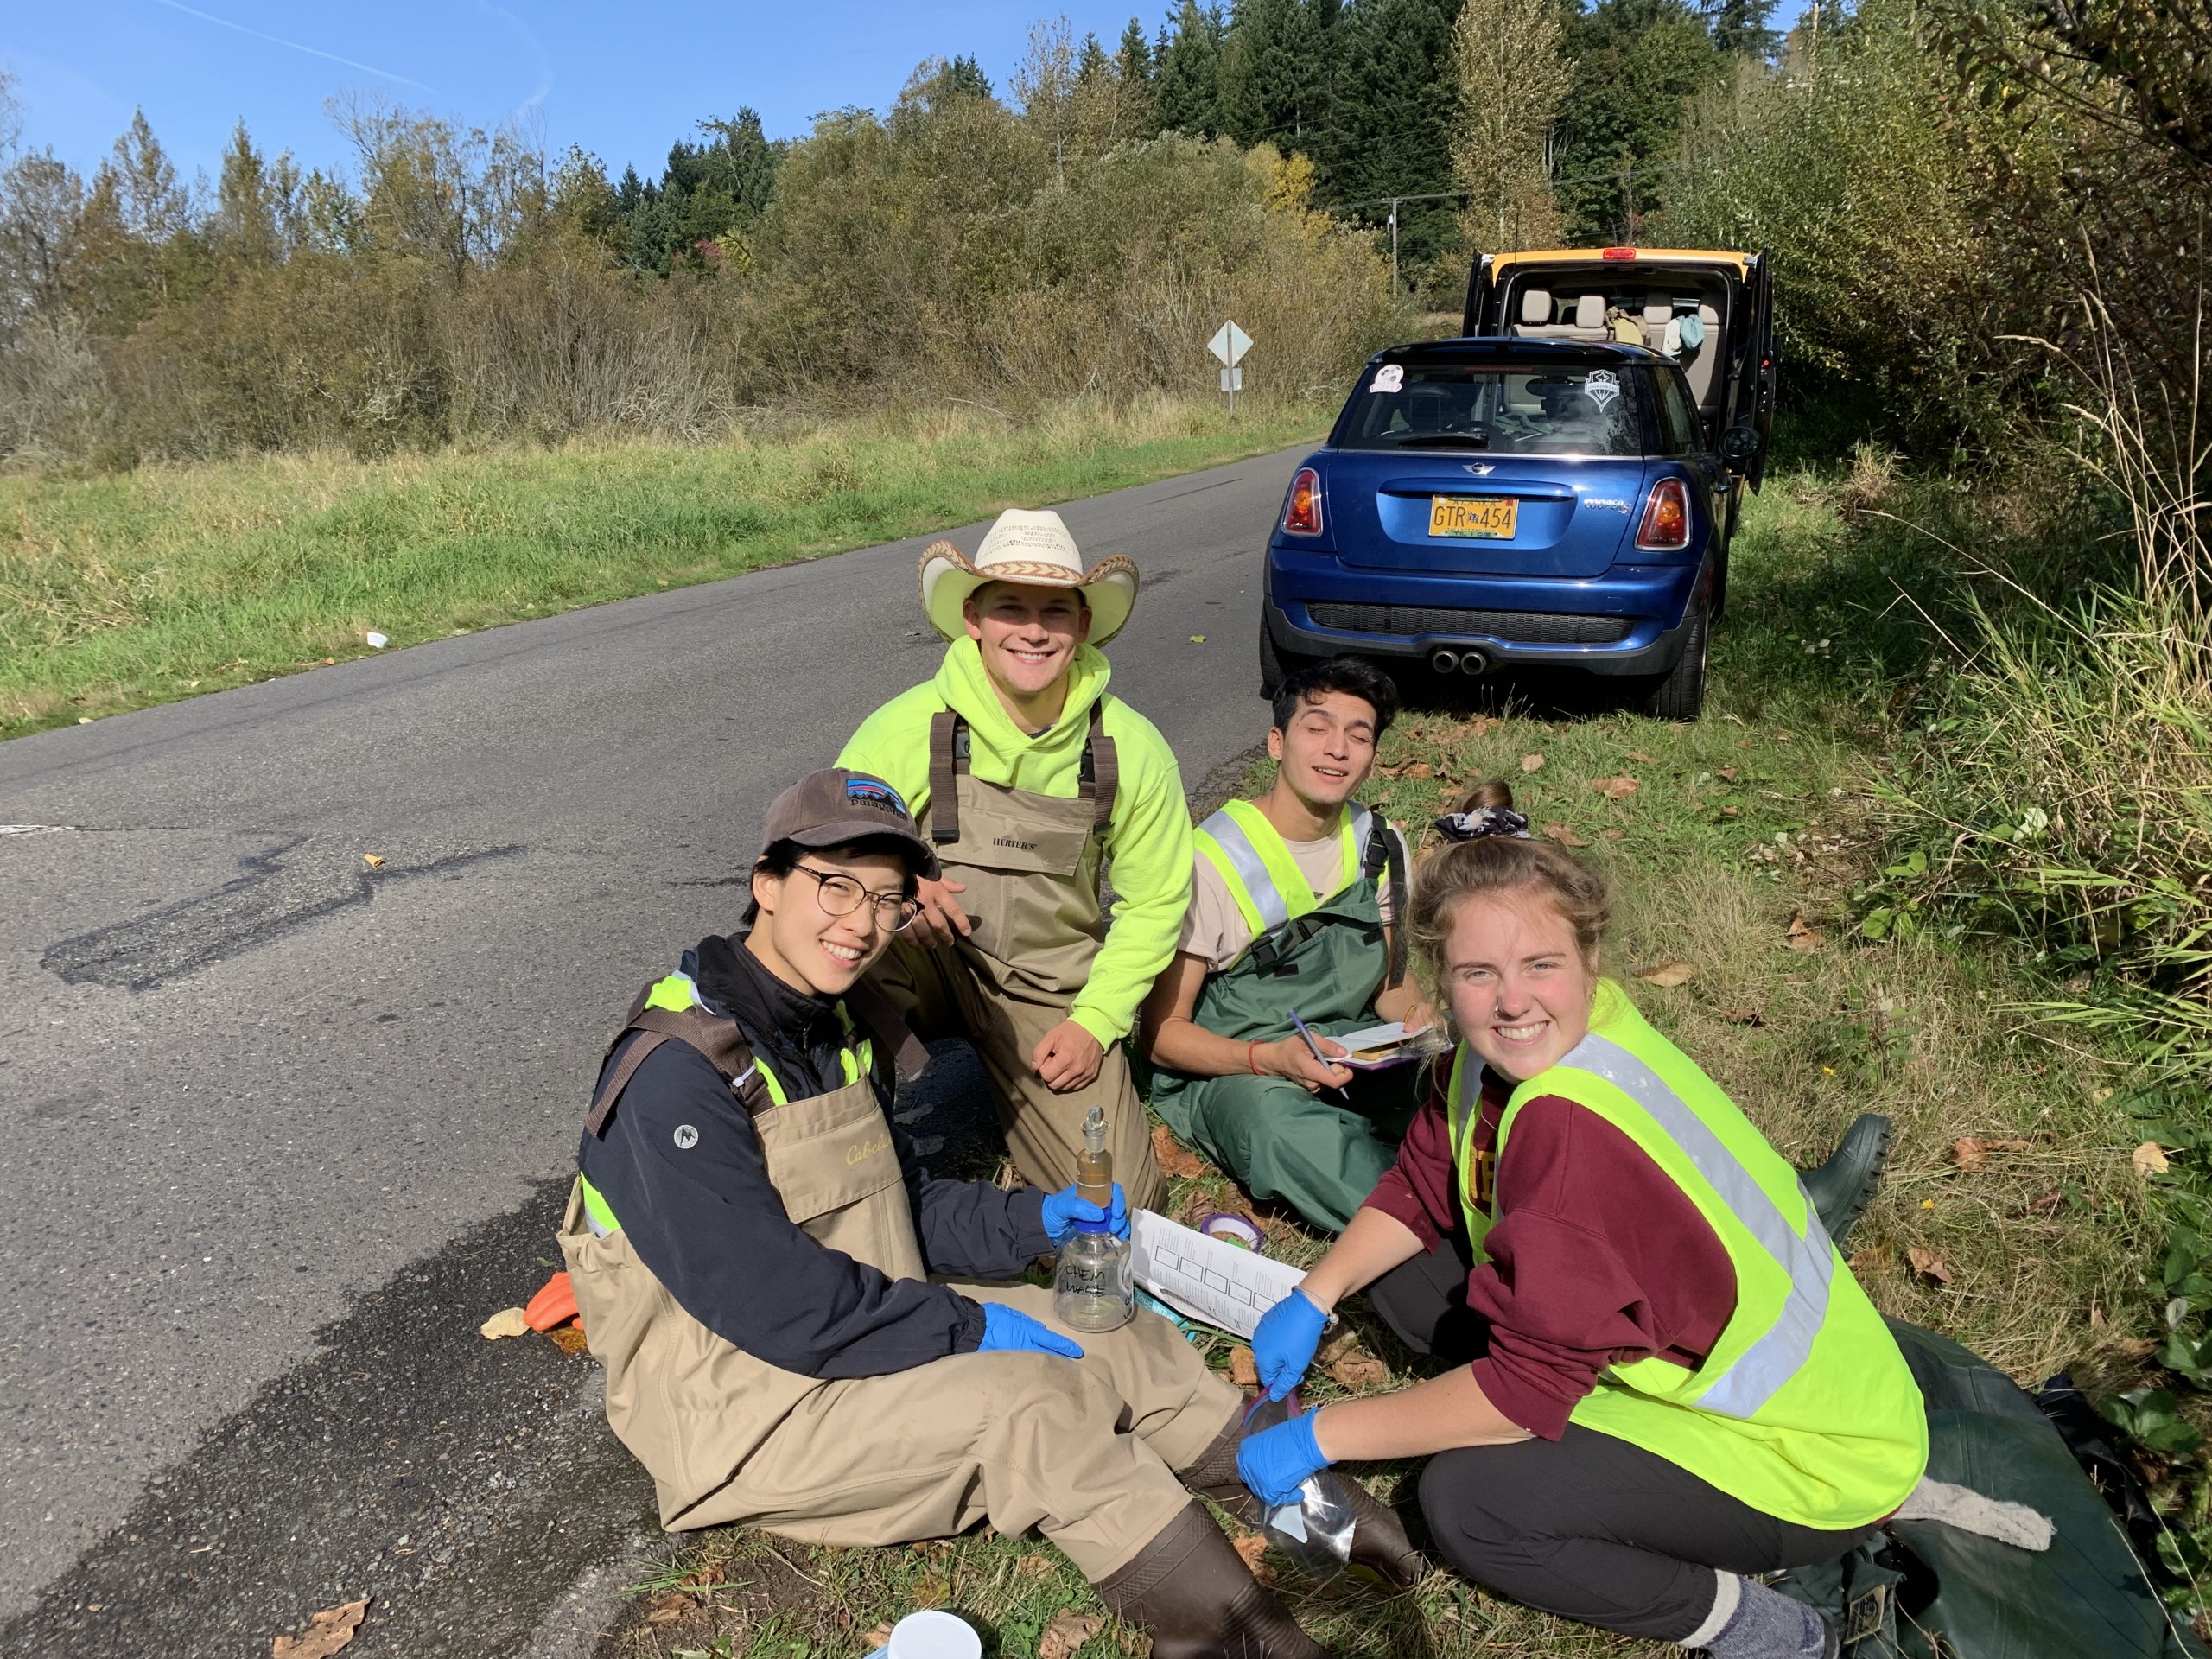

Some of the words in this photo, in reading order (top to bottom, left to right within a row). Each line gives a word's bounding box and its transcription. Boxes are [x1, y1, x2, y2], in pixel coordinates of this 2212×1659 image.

[1434, 505, 1466, 527] GTR
[1480, 507, 1512, 530] 454
[993, 837, 1036, 850] HERTER'S
[1065, 1265, 1105, 1281] CHEM
